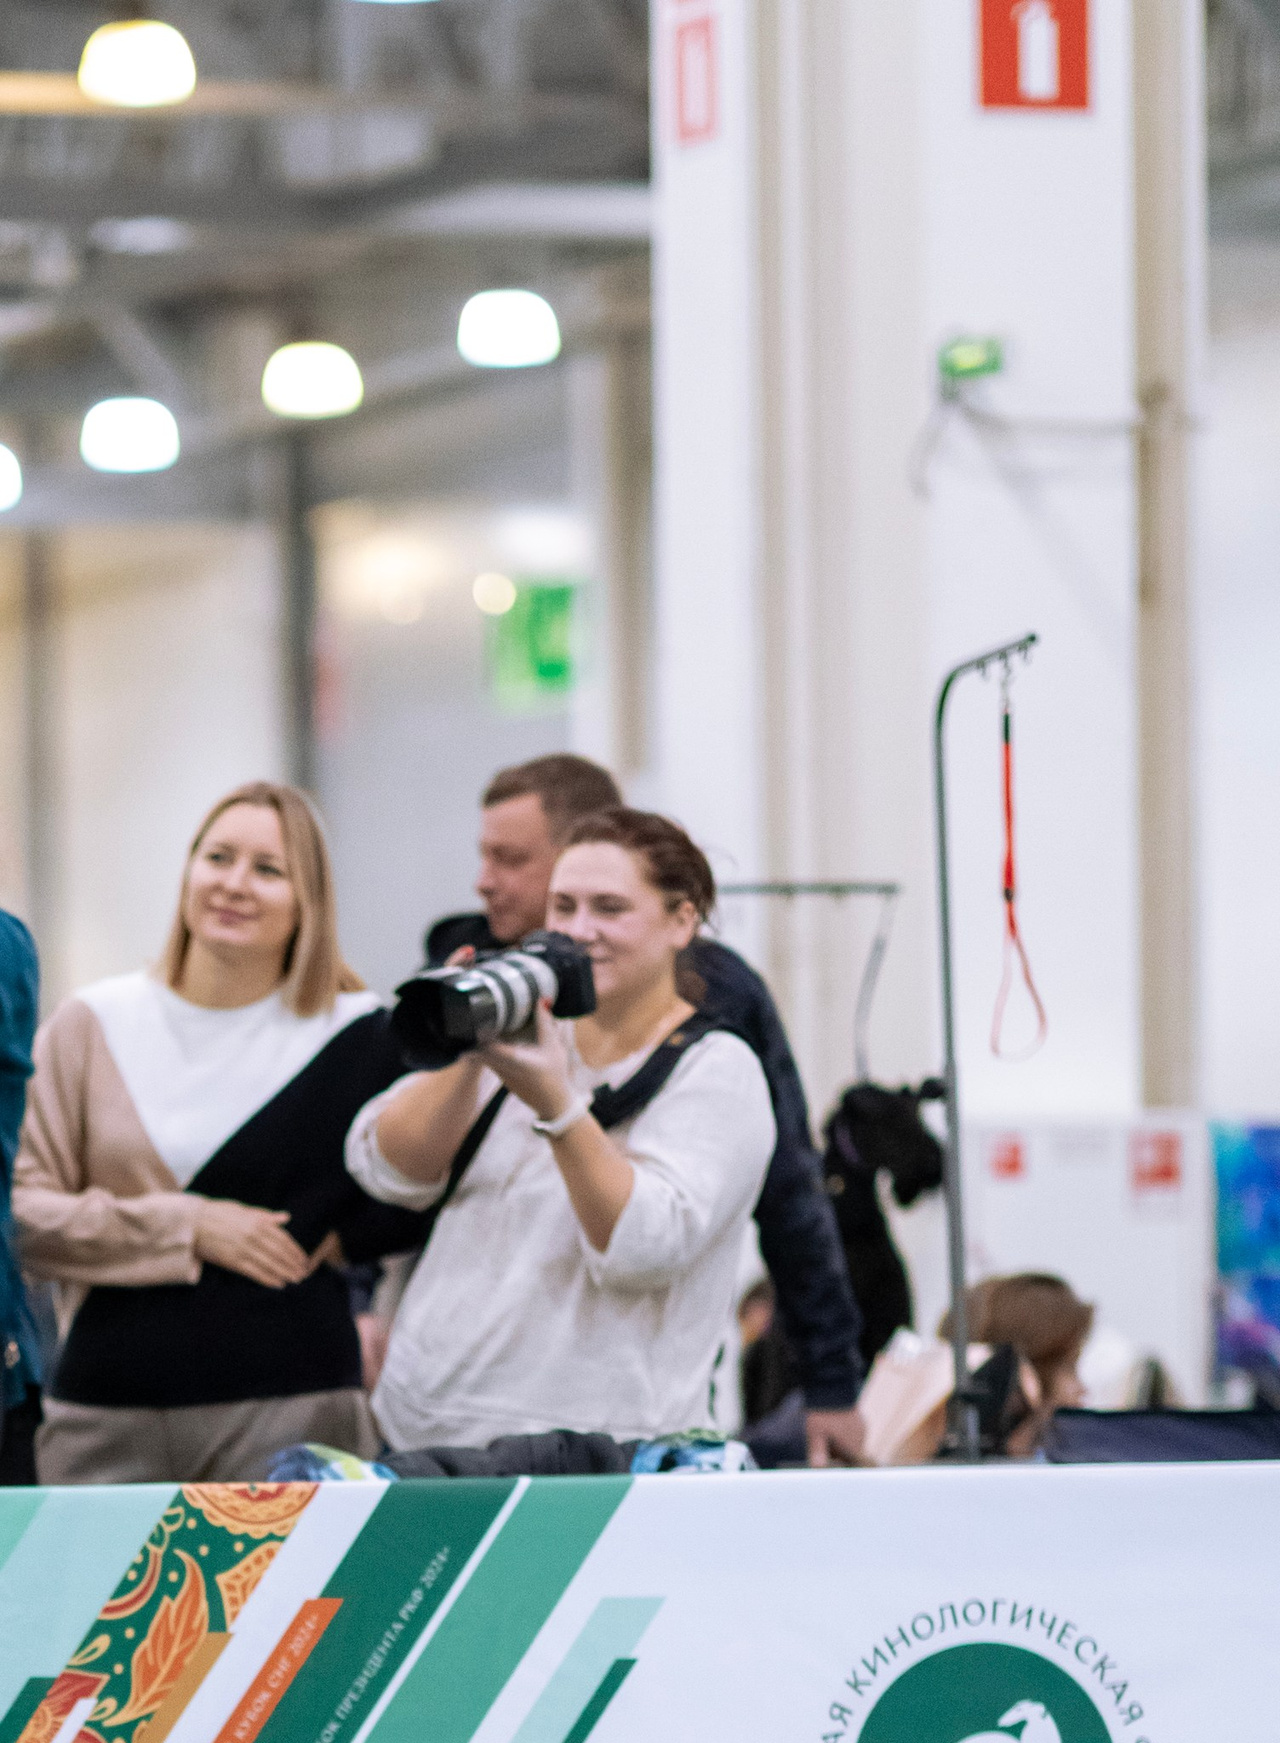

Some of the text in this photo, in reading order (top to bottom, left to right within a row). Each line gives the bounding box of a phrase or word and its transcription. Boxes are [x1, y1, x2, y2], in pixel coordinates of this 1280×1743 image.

[234, 1690, 271, 1740] КУБОК
[266, 1656, 291, 1689] СНГ
[335, 1621, 405, 1720] ПРЕЗИДЕНТА
[397, 1588, 425, 1622] РКФ
[844, 1597, 1145, 1727] КИНОЛОГИЧЕСКАЯ
